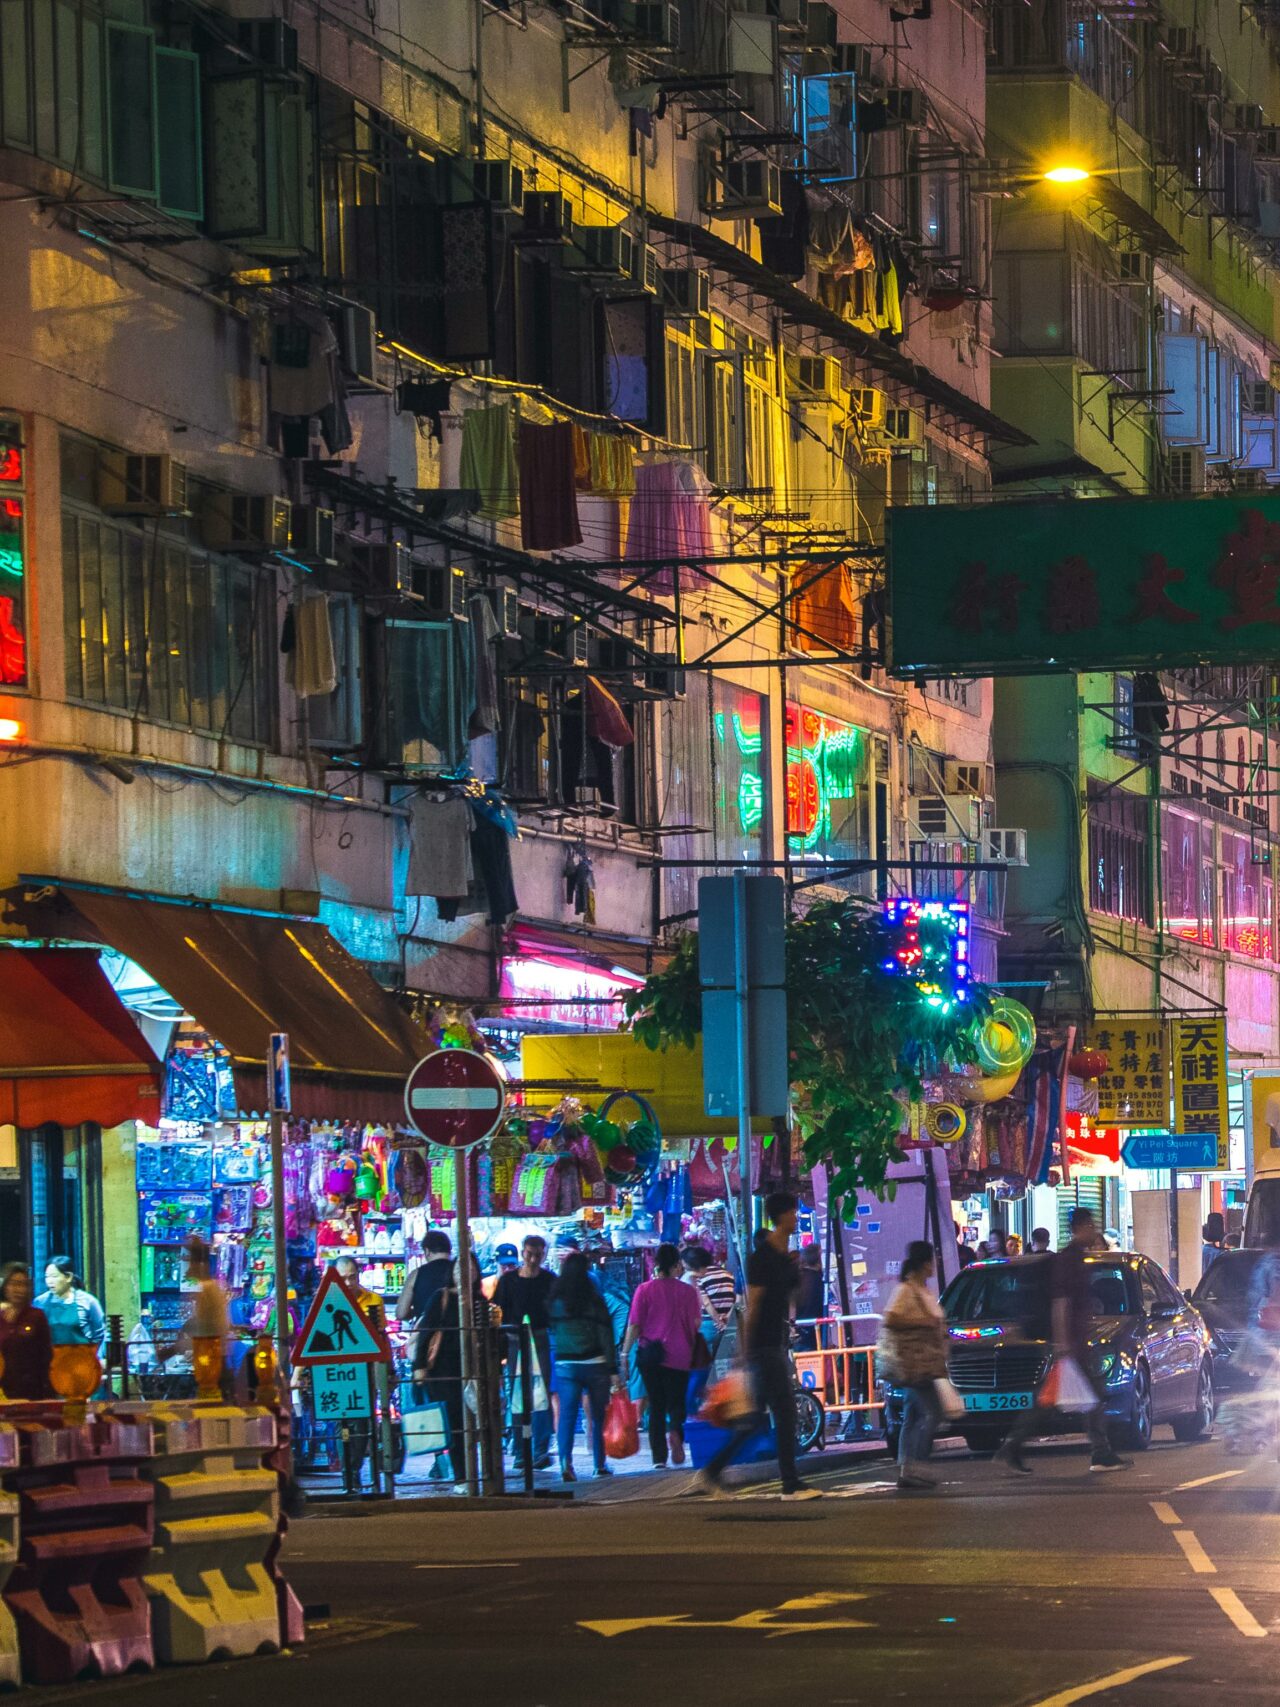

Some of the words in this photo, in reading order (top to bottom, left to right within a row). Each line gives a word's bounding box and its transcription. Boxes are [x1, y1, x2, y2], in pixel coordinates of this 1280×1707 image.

[1138, 1140, 1147, 1148] Yi
[1149, 1140, 1164, 1148] Pei
[1167, 1139, 1198, 1149] Square
[325, 1367, 357, 1381] End
[320, 1390, 365, 1413] 終止
[989, 1395, 1030, 1410] 5268
